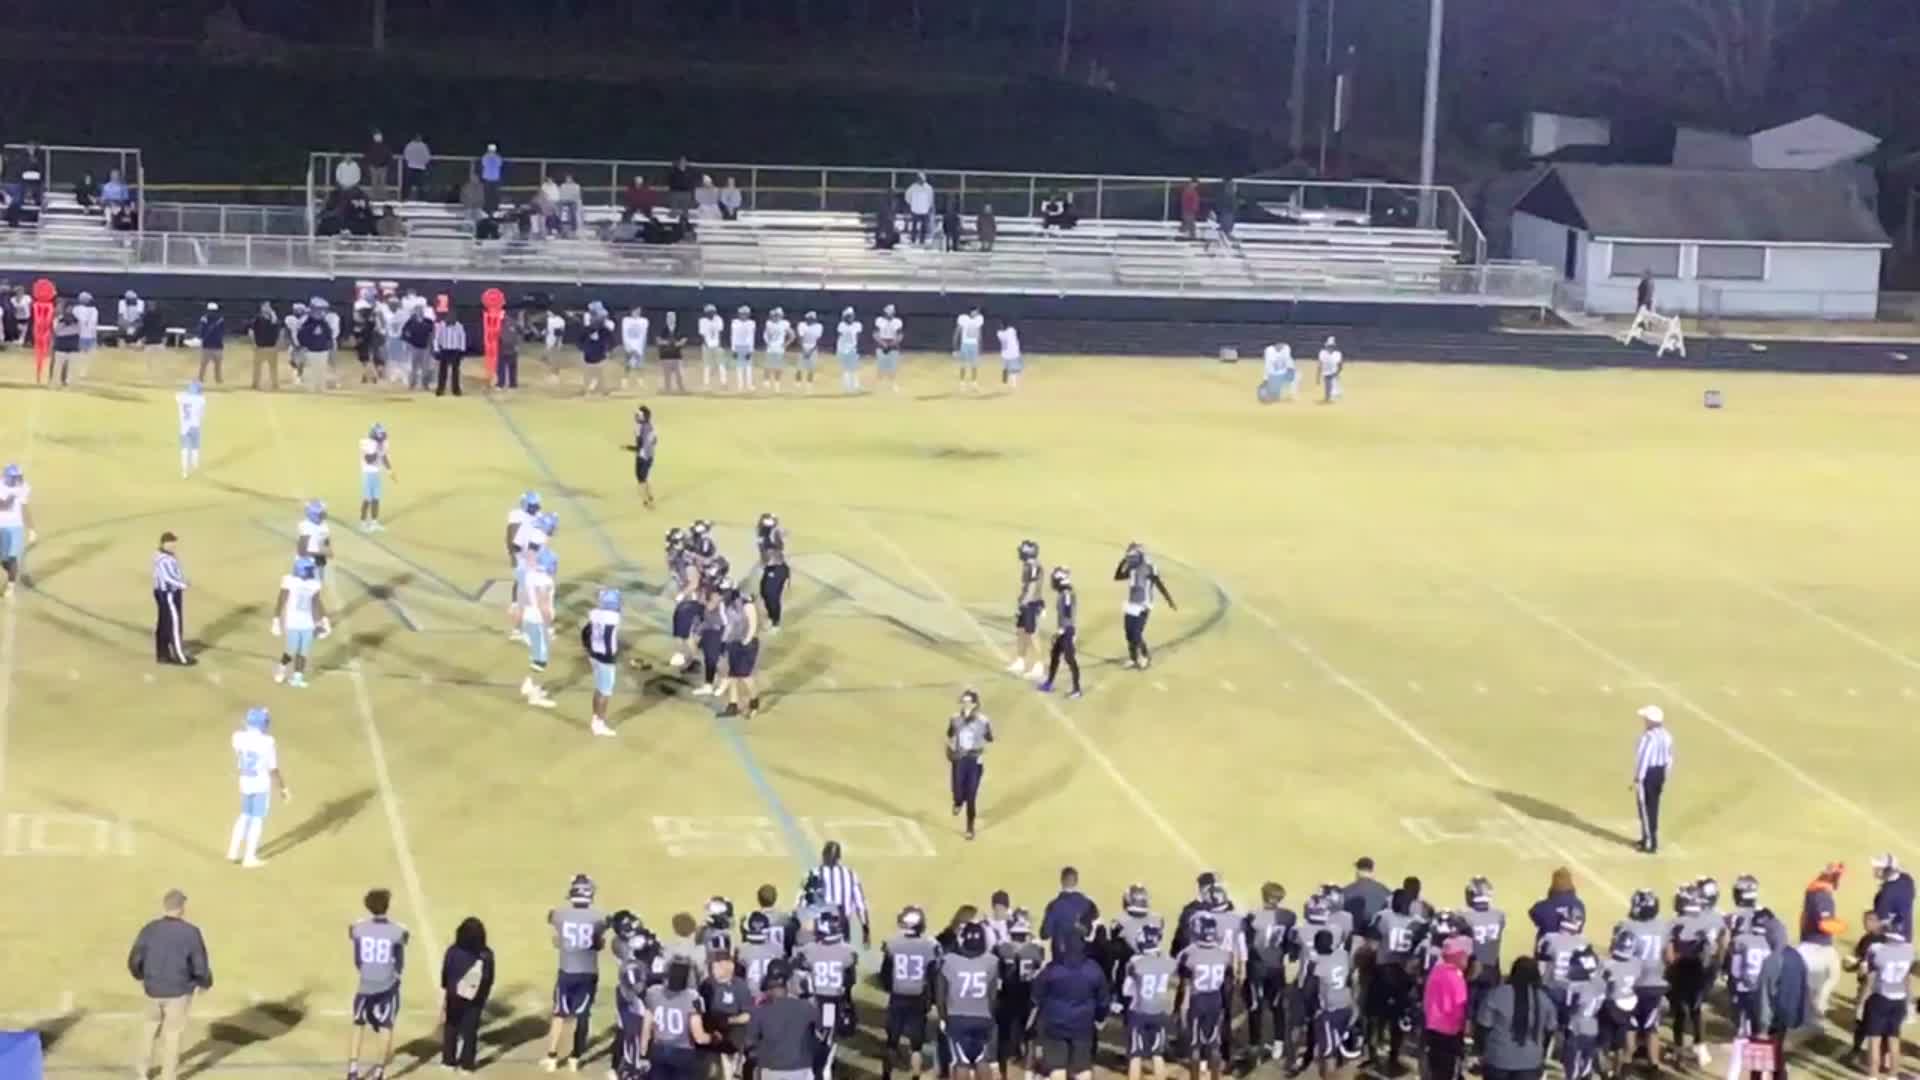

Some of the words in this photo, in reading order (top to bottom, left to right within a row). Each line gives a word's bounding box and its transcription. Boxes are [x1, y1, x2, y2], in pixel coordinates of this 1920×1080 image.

[562, 920, 593, 949] 58
[361, 936, 390, 963] 88
[813, 961, 843, 988] 85
[894, 953, 924, 980] 83
[957, 970, 988, 998] 75
[654, 1005, 684, 1034] 40
